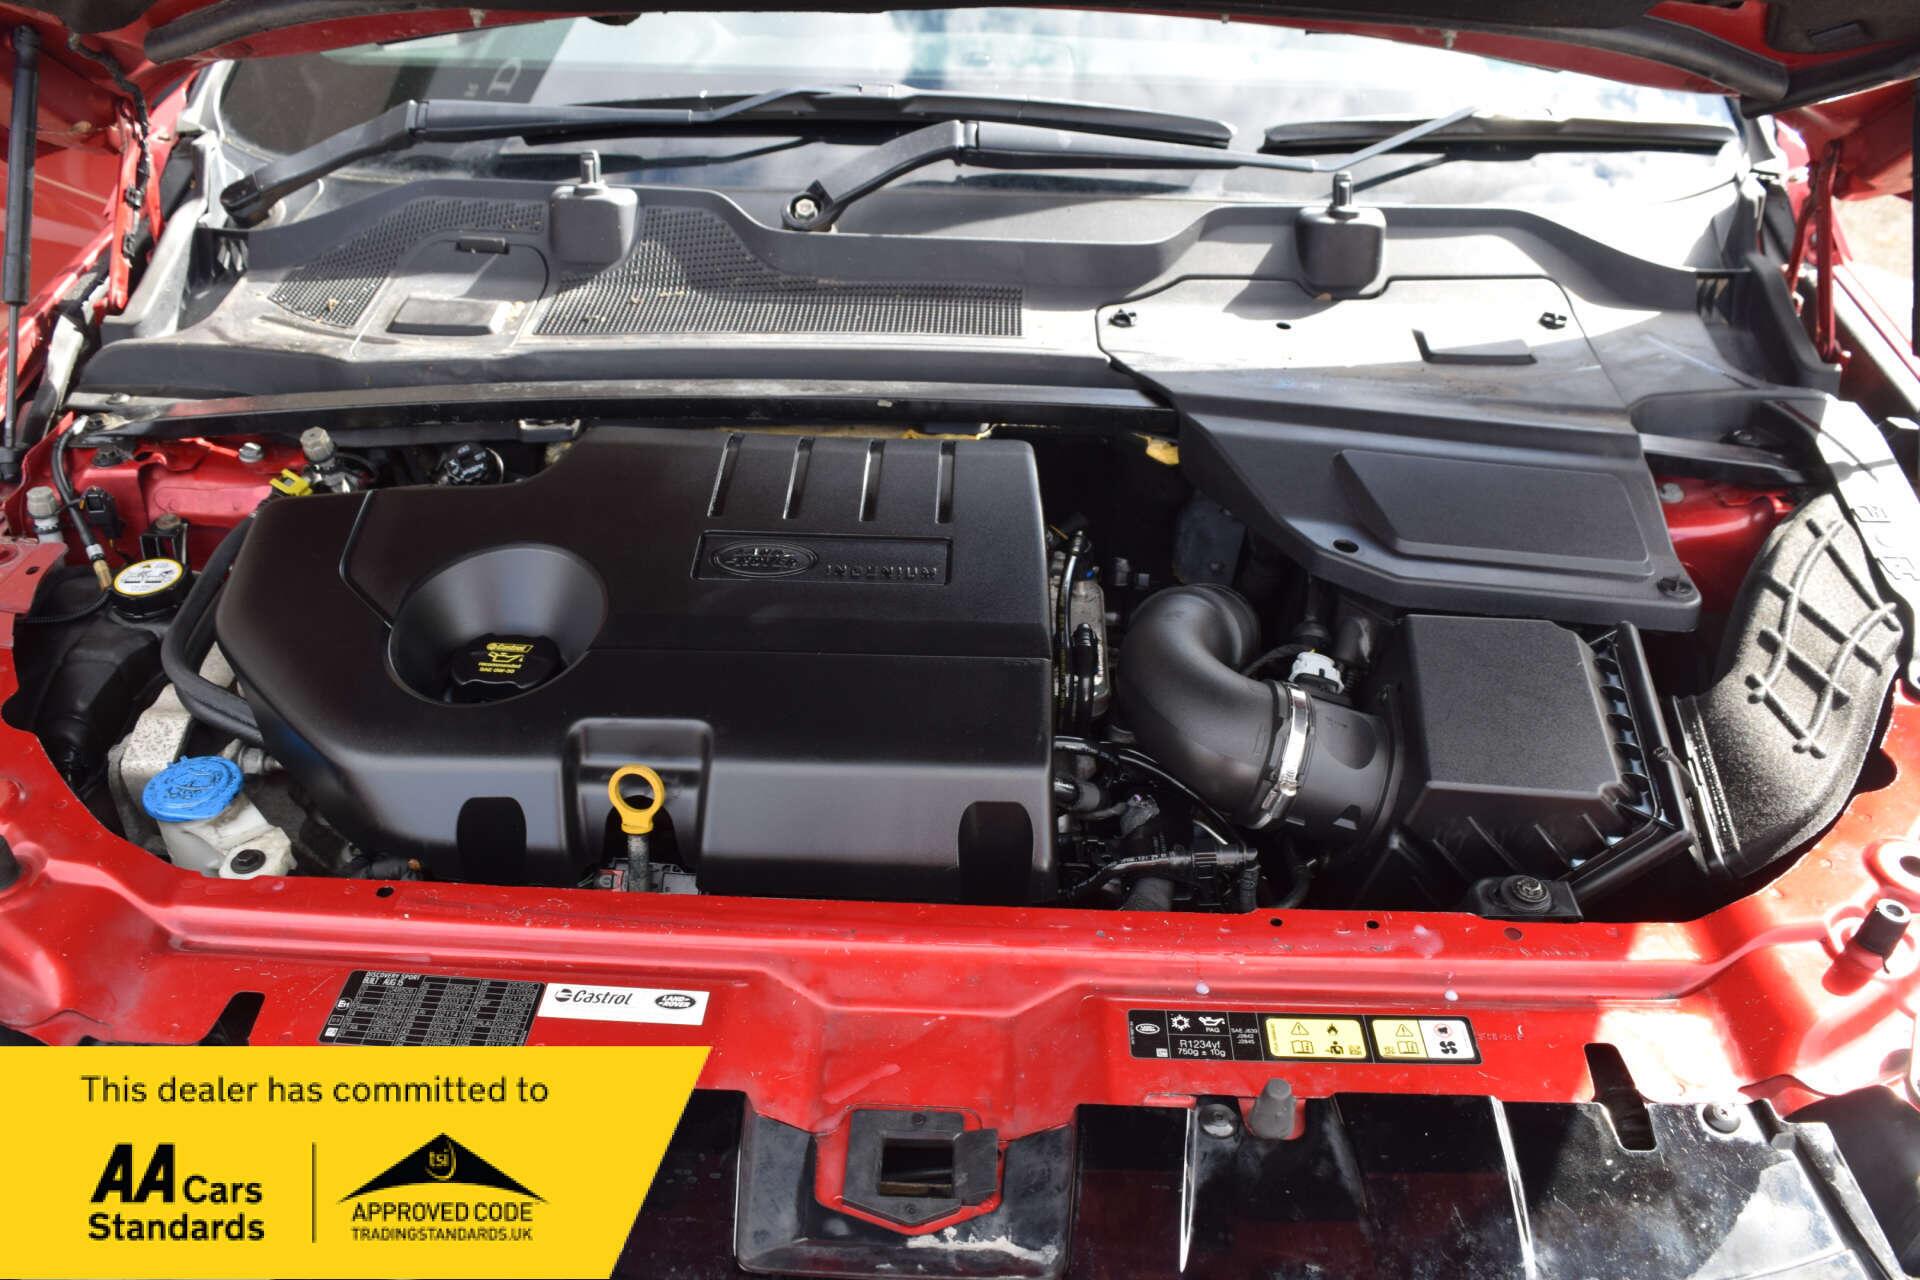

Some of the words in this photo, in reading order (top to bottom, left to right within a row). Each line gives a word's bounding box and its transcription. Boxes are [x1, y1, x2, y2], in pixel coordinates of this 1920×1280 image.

[572, 989, 633, 1006] Castrol
[1179, 1039, 1221, 1050] R1234yf
[1178, 1047, 1200, 1057] 750g
[1210, 1047, 1227, 1058] 10g
